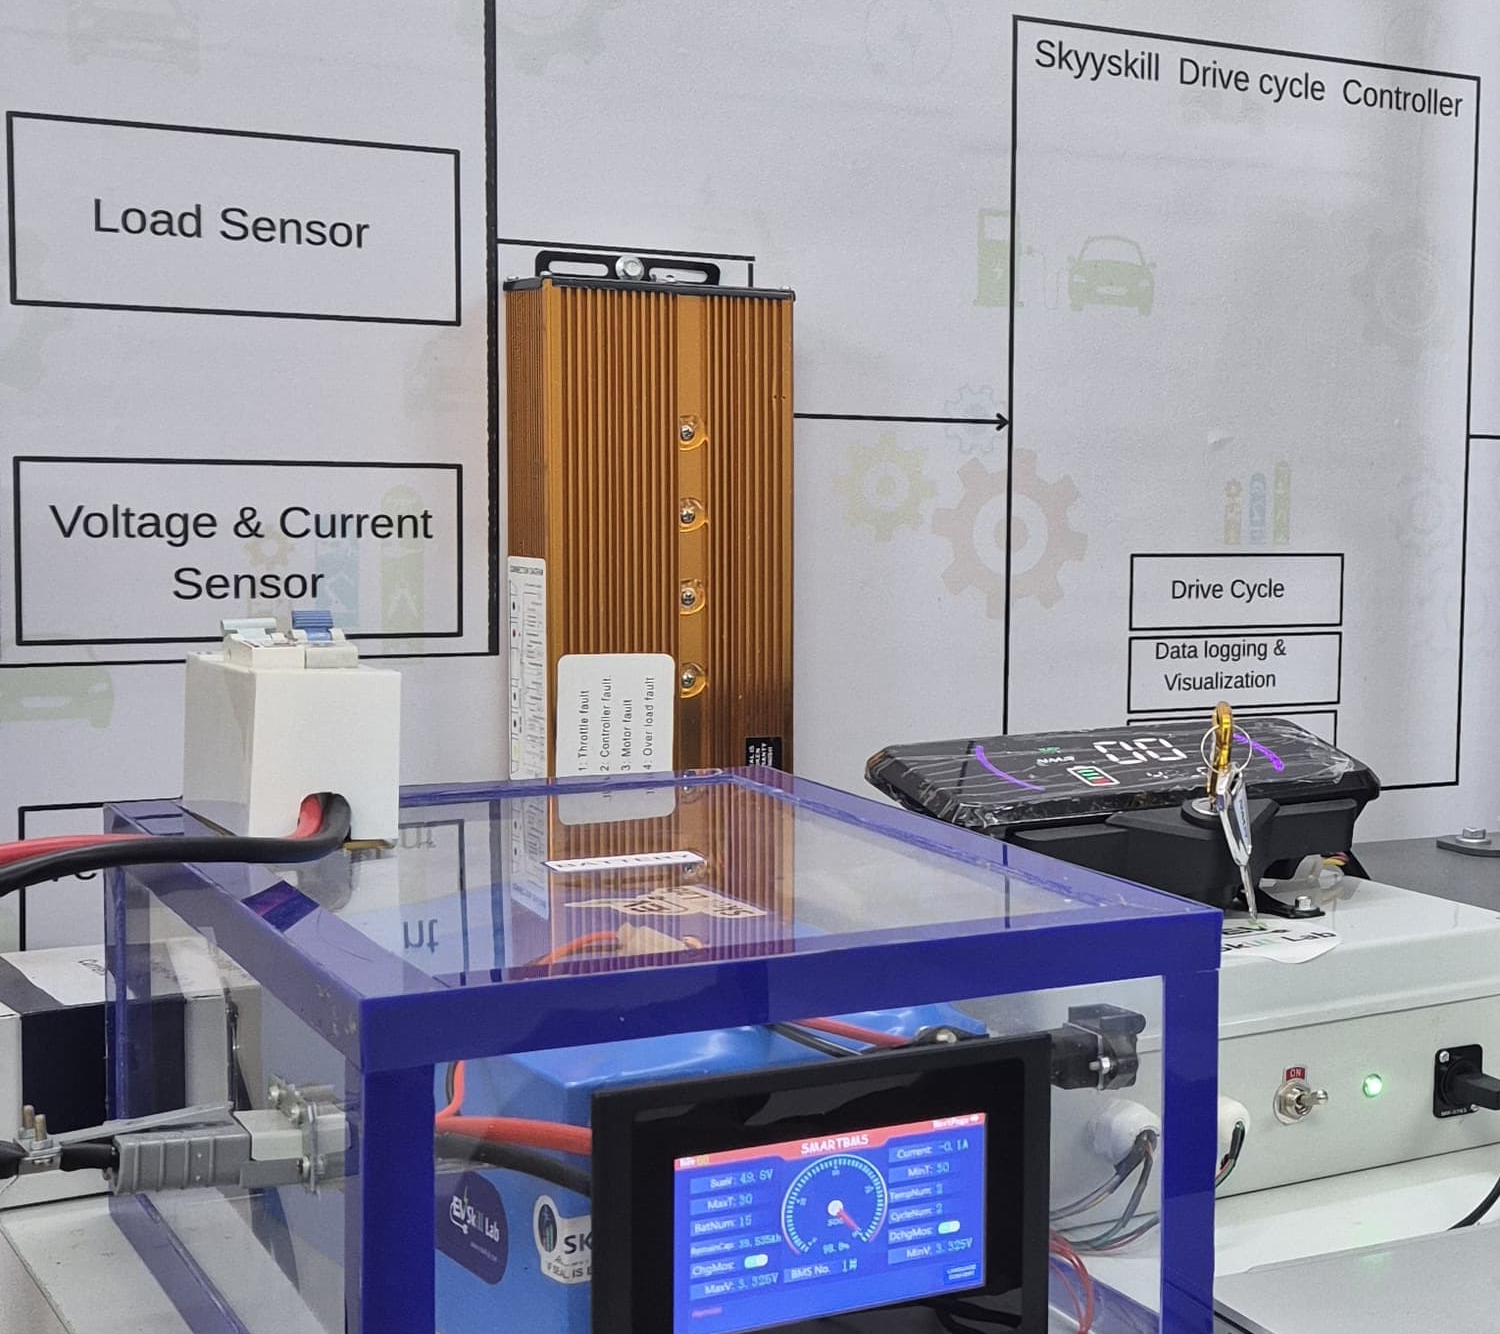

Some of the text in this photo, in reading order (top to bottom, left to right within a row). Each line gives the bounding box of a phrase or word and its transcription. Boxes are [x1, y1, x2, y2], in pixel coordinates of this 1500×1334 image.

[1036, 39, 1463, 117] Skyyskill Drive cycle Controller
[95, 198, 369, 248] Load Sensor
[49, 504, 433, 547] Voltage & Current
[174, 567, 324, 600] Sensor
[1172, 578, 1284, 603] Drive Cycle
[1156, 638, 1286, 663] Data logging &
[1164, 671, 1275, 691] Visualization
[579, 690, 589, 714] fault
[622, 700, 633, 723] fault
[600, 705, 611, 758] Controller
[643, 677, 654, 770] 4: Over load fault
[578, 718, 589, 758] Throttle
[621, 726, 632, 757] Motor
[600, 762, 609, 772] 2:
[801, 1134, 869, 1155] SMARTBMS
[485, 1217, 500, 1243] Lab
[791, 1266, 812, 1280] BMS
